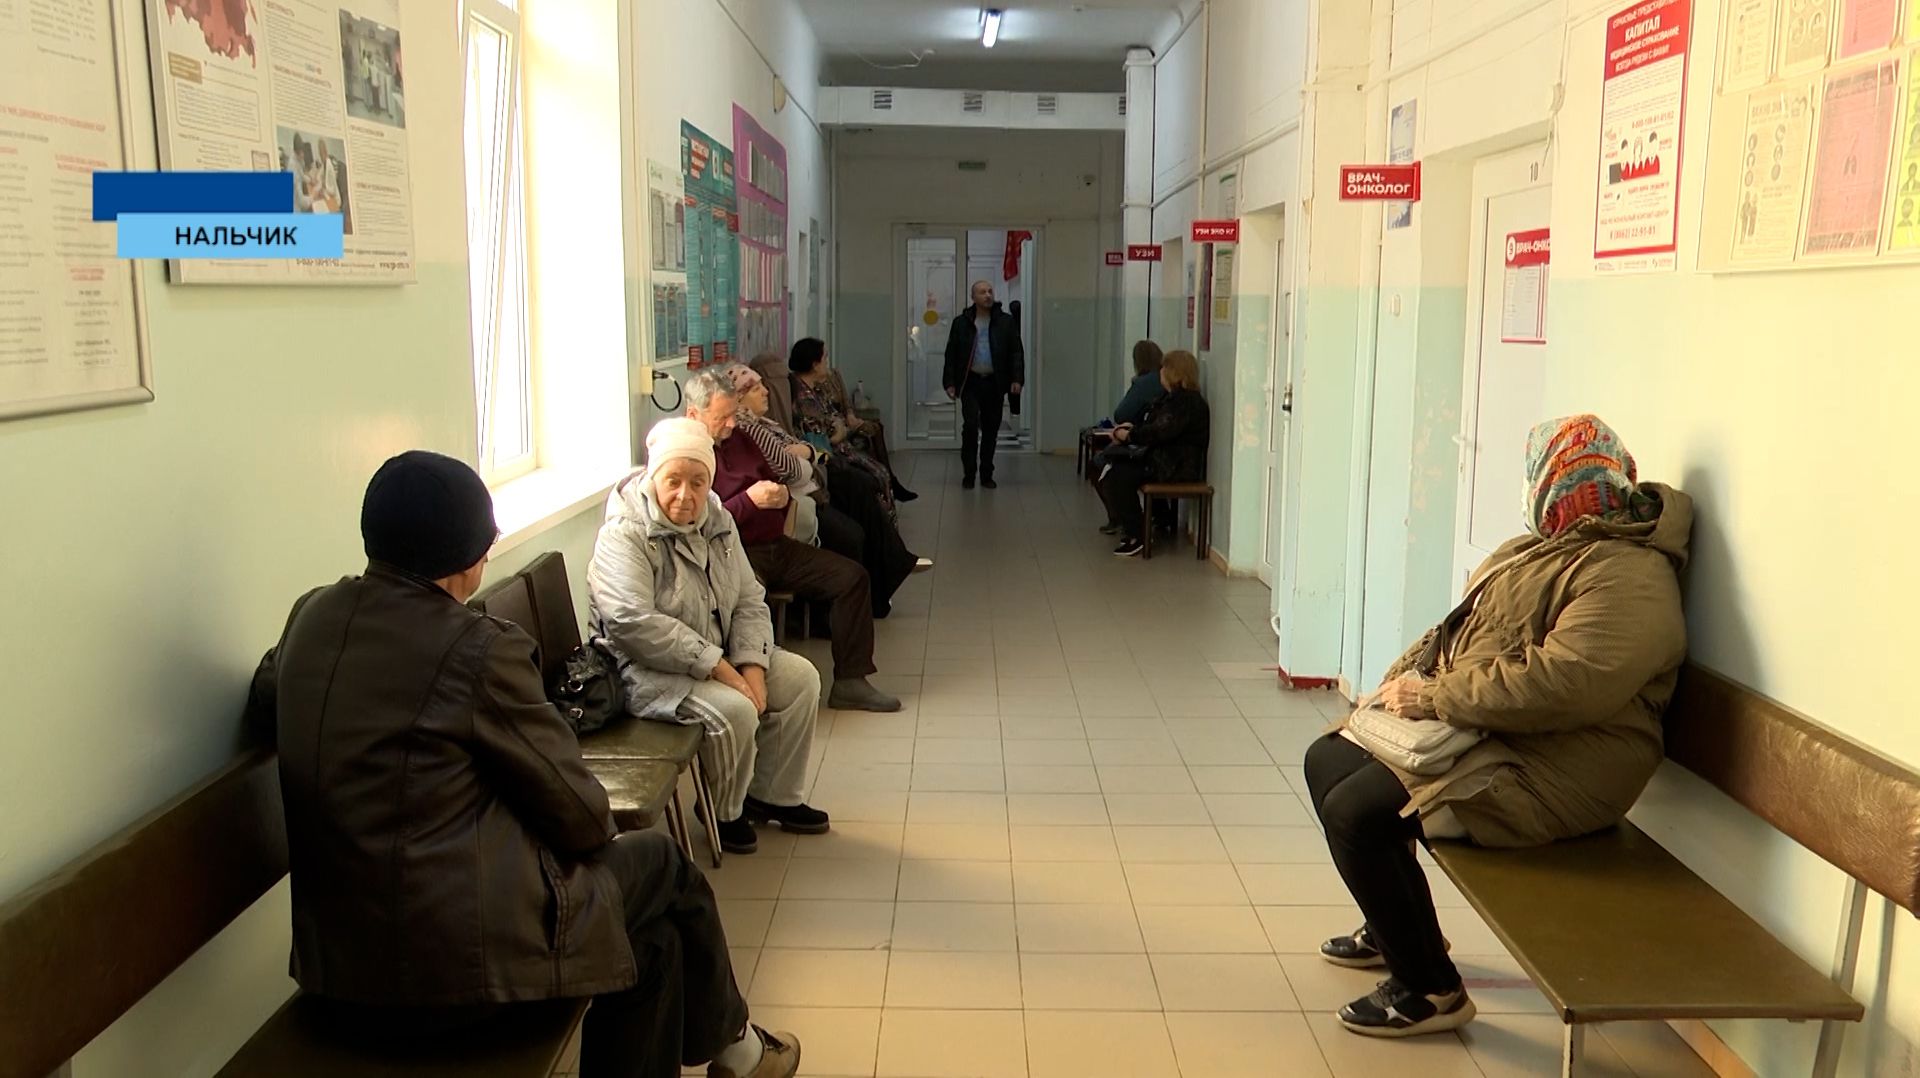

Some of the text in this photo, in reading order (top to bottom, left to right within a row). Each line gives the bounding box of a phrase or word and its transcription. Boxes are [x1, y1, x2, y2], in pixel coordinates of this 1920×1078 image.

[1625, 15, 1660, 43] КАПИТАЛ
[1347, 172, 1386, 183] ВРАЧ-
[1530, 161, 1539, 183] 10
[1347, 184, 1412, 195] ОНКОЛОГ
[1135, 249, 1155, 257] УЗИ
